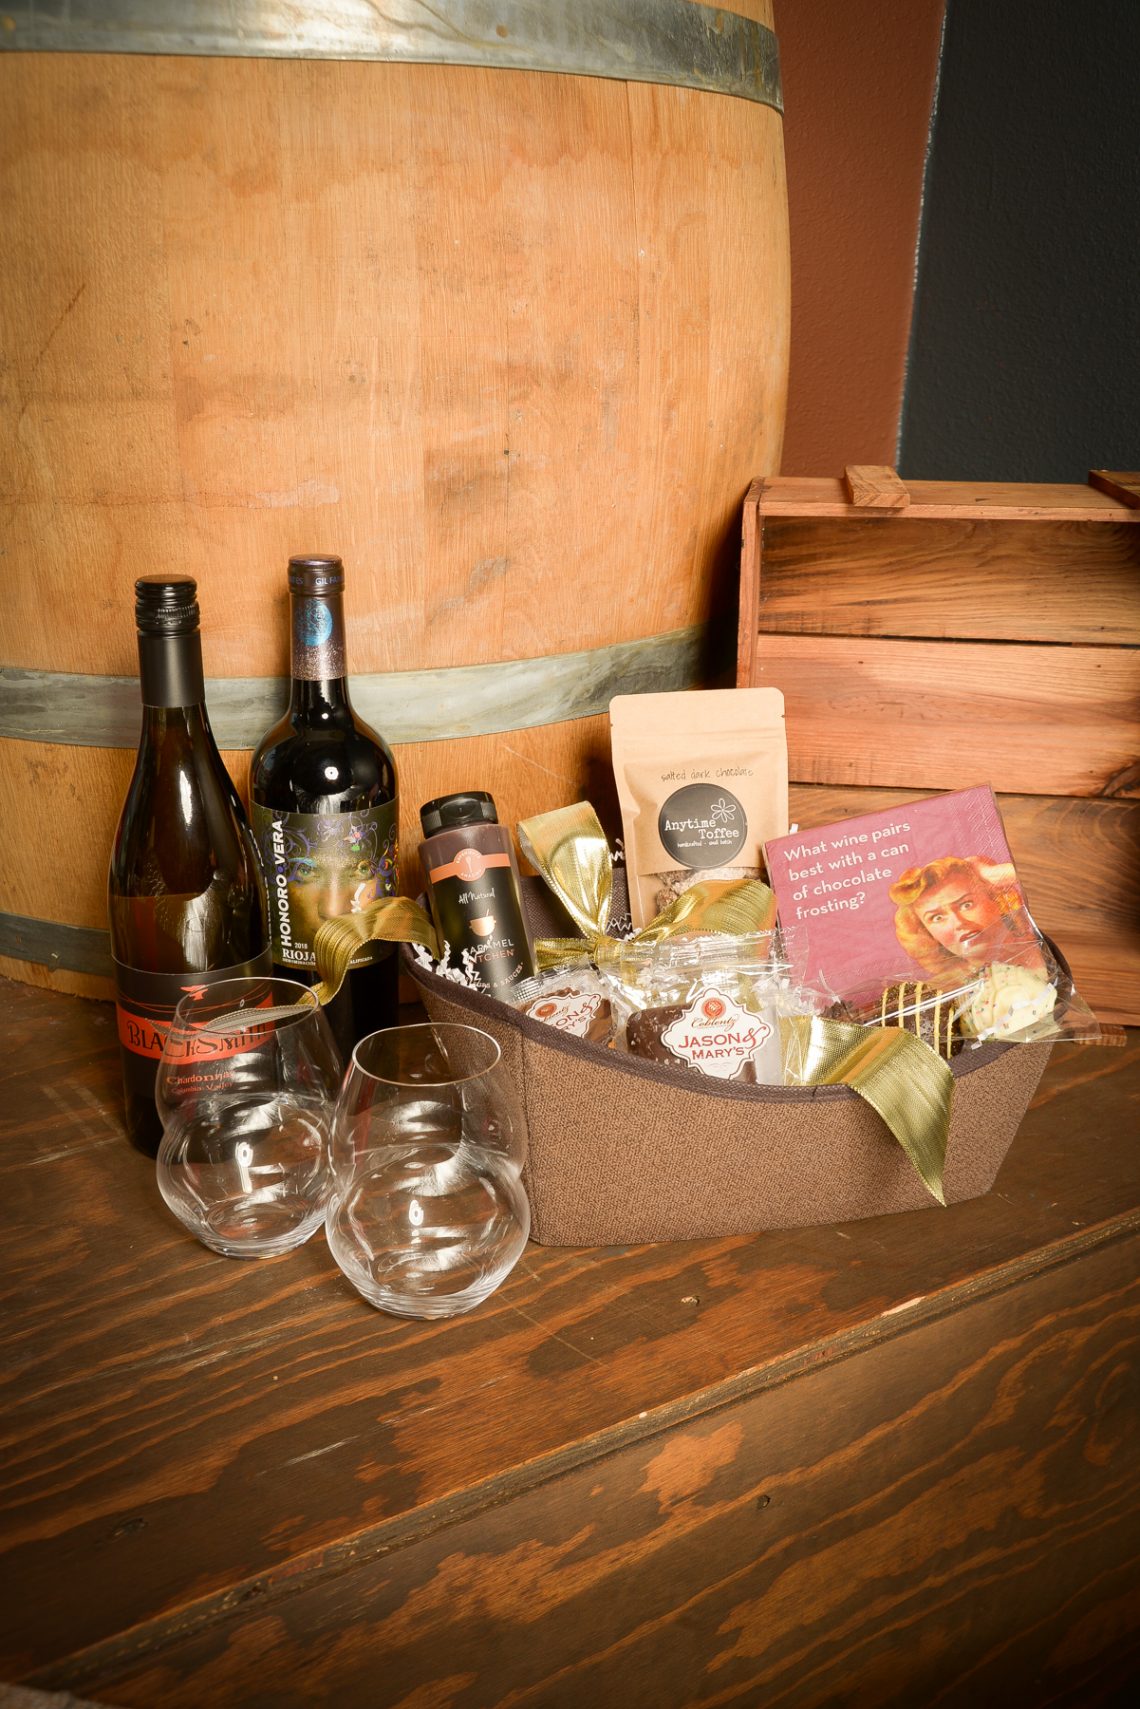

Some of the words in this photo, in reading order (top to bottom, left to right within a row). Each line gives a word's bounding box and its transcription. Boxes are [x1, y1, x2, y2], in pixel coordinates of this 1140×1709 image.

[315, 577, 328, 586] GIL
[661, 771, 686, 782] salted
[691, 769, 711, 780] dark
[716, 767, 754, 778] chocolate
[664, 818, 716, 832] Anytime
[698, 827, 740, 840] Toffee
[271, 820, 288, 866] VERA
[784, 840, 828, 862] What
[831, 834, 868, 849] wine
[872, 822, 911, 843] pairs
[788, 862, 824, 881] best
[828, 852, 863, 870] with
[867, 851, 877, 861] a
[881, 843, 909, 858] can
[792, 885, 809, 901] of
[813, 866, 892, 895] chocolate
[275, 873, 292, 947] HONORO
[796, 891, 866, 920] frosting?
[282, 948, 316, 961] RIOJA
[678, 1032, 741, 1049] JASON
[691, 1046, 745, 1060] MARY'S
